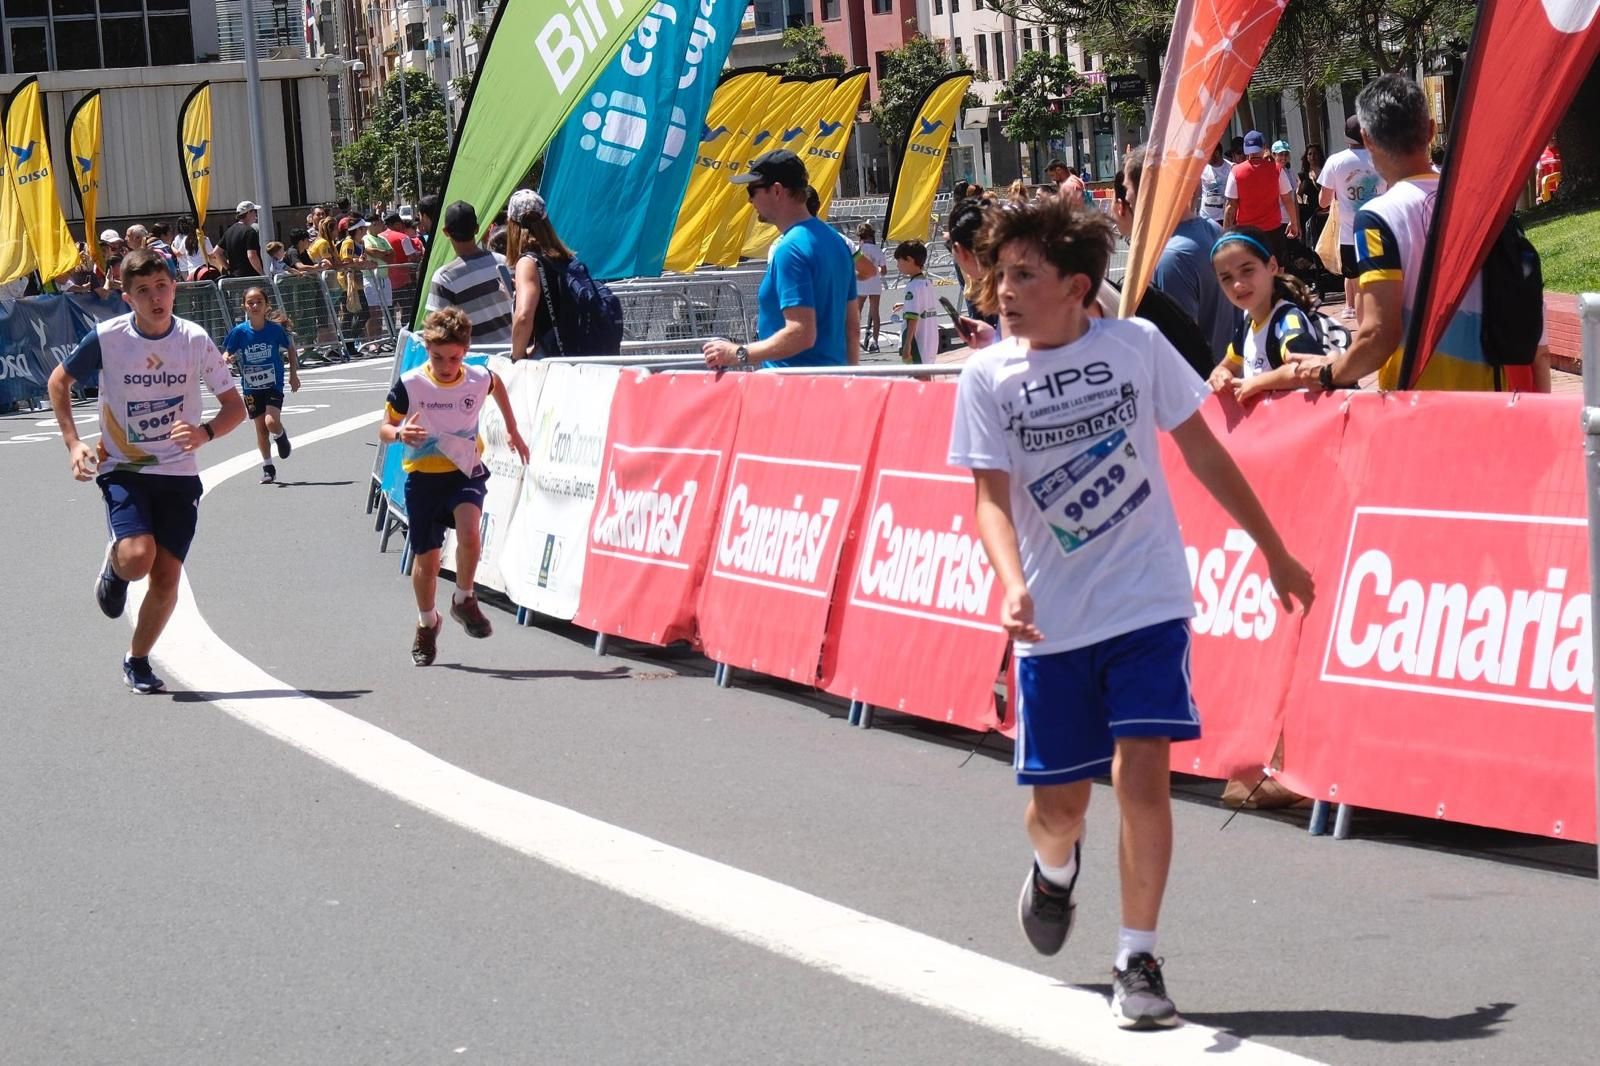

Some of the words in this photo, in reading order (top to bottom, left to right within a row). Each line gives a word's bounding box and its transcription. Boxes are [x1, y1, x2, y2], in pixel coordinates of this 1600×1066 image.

[123, 371, 187, 388] sagulpa
[1021, 361, 1114, 405] HPS
[138, 411, 175, 431] 9067
[1029, 404, 1061, 419] CARRERA
[1060, 400, 1070, 410] DE
[1081, 387, 1118, 404] EMPRESAS
[1024, 421, 1087, 447] JUNIOR
[1093, 402, 1134, 431] RACE
[1033, 468, 1069, 501] HPS
[1064, 464, 1126, 522] 9029
[719, 483, 840, 584] Canarias7
